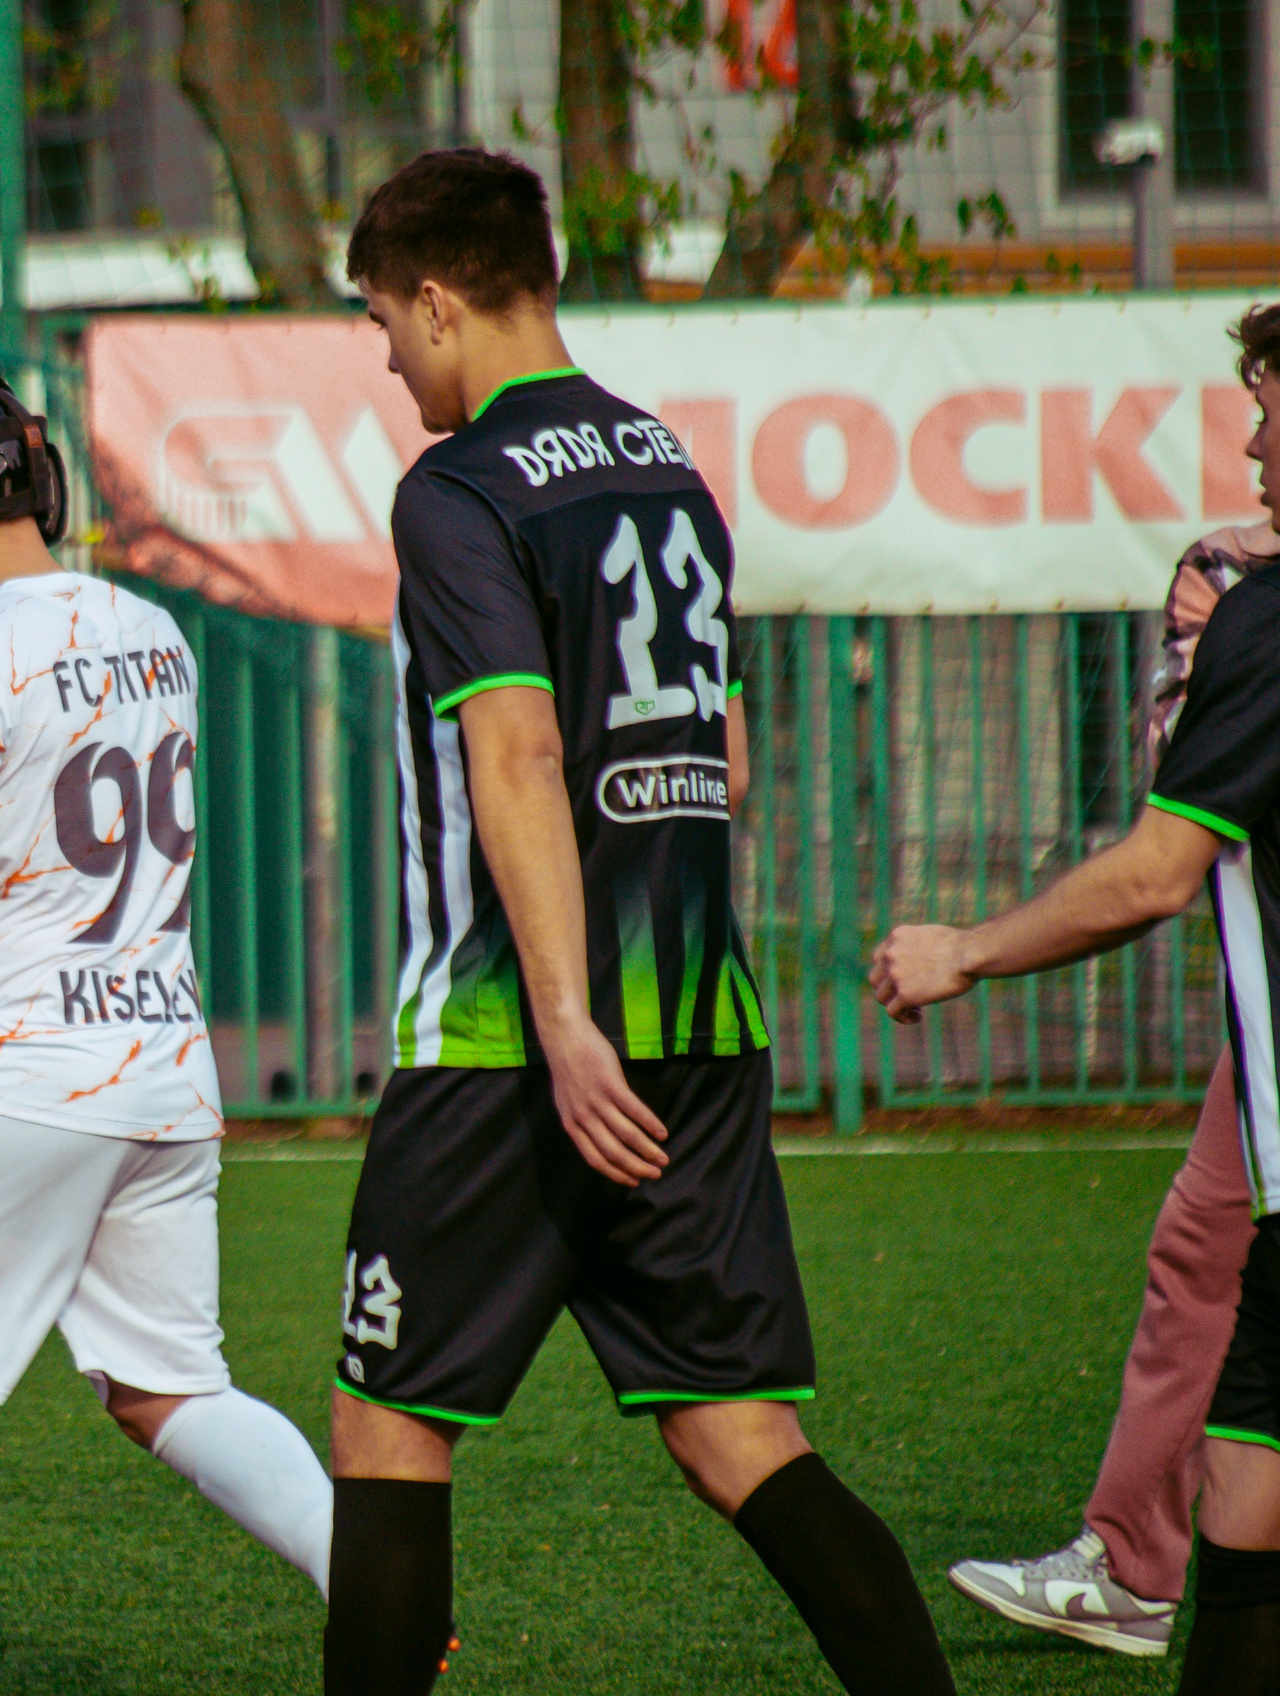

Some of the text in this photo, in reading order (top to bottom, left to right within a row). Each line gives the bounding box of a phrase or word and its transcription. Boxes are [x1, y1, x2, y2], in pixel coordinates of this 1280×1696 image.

[53, 646, 191, 713] FC TITAN
[605, 508, 729, 730] 13
[54, 731, 196, 944] 99
[617, 769, 728, 808] Winline
